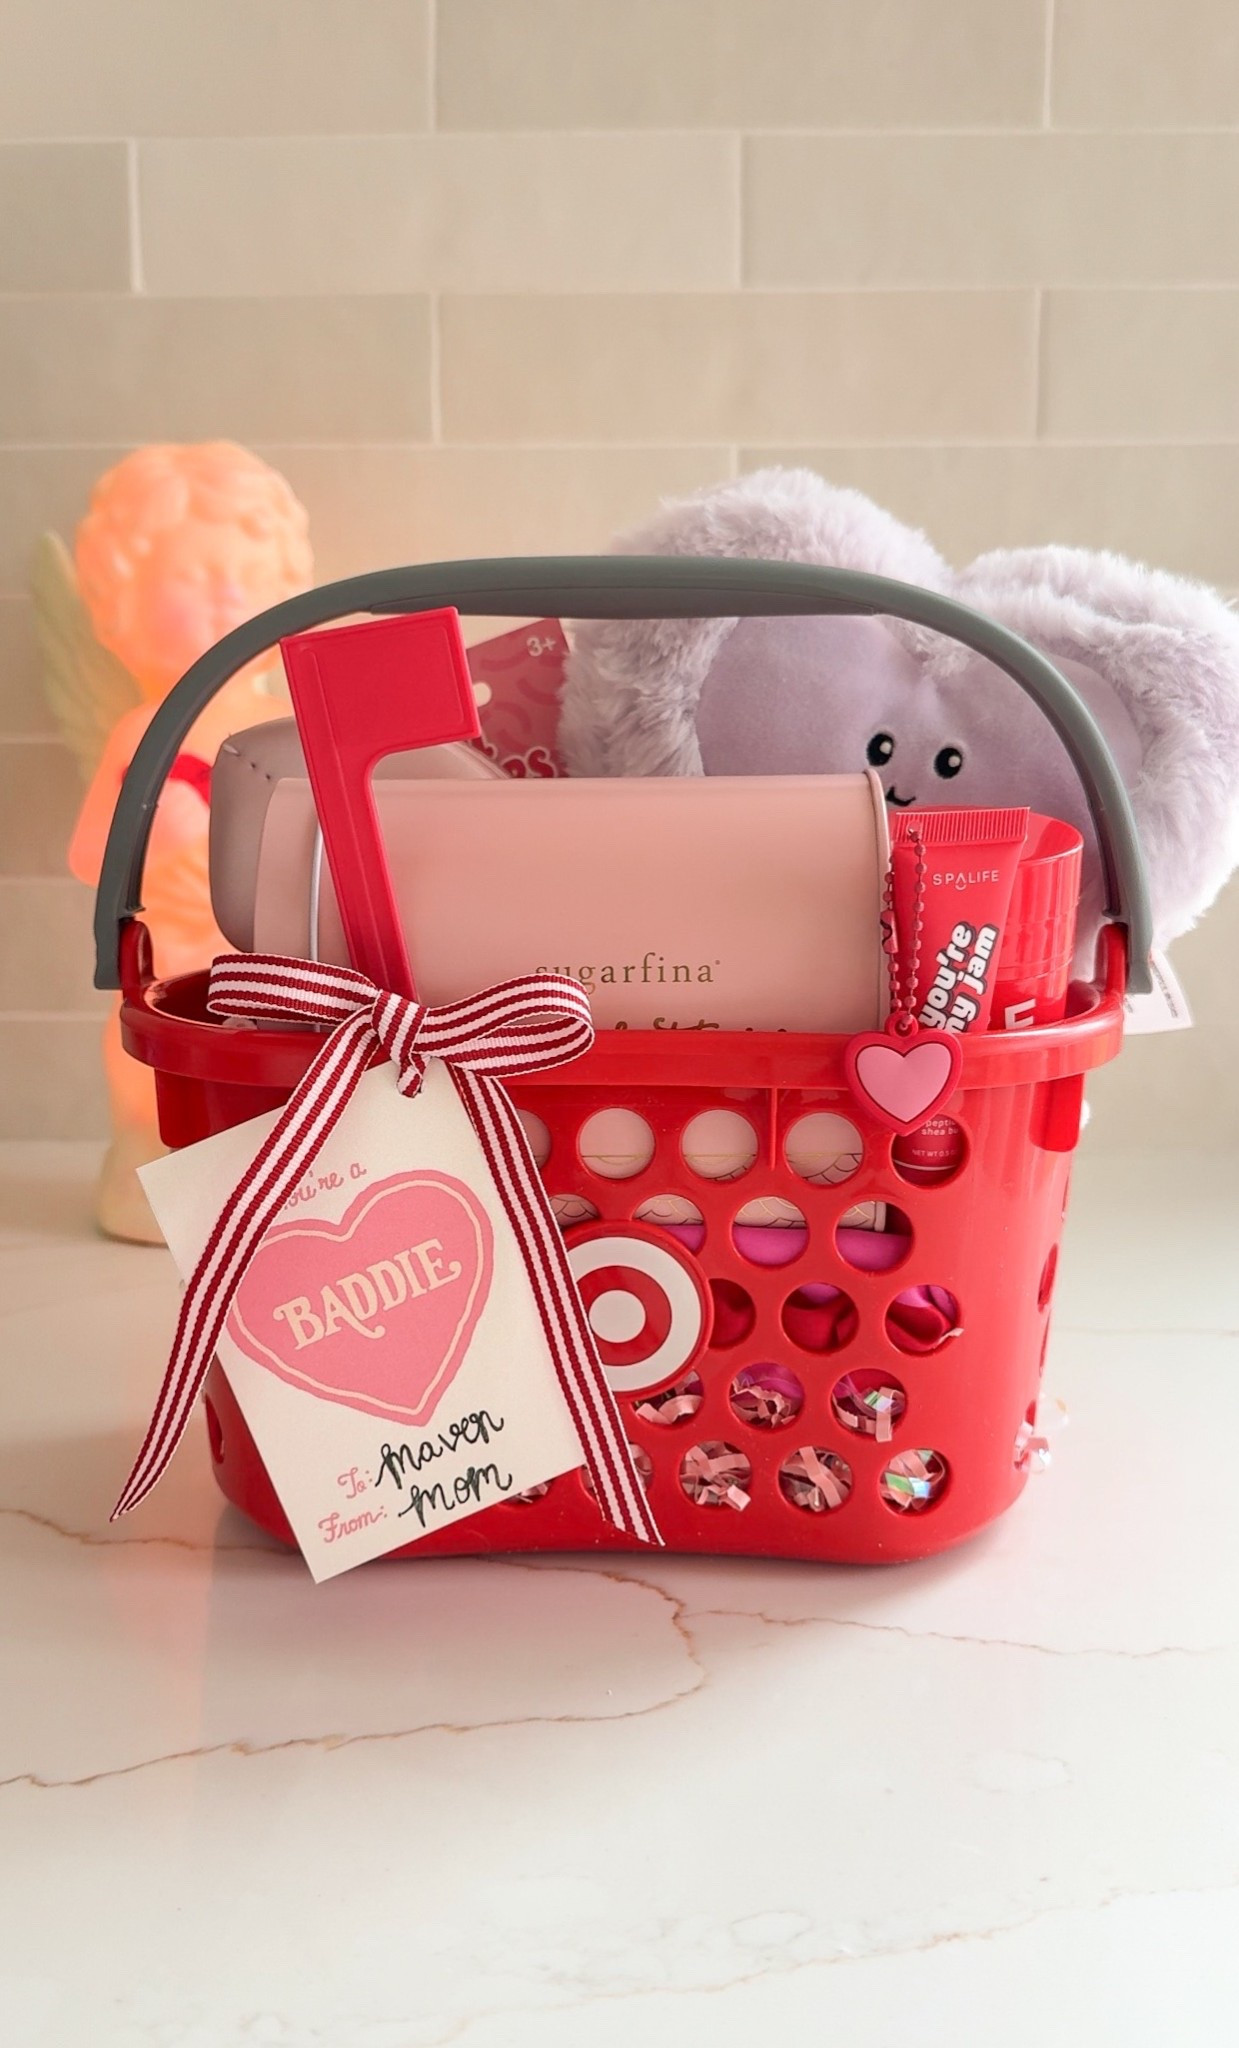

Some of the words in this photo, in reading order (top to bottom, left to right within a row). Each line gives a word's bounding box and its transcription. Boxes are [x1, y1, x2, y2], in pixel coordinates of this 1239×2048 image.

[526, 637, 556, 656] 3+
[932, 870, 999, 890] SPALIFE
[917, 924, 974, 1030] you're
[957, 926, 997, 995] jam
[284, 1170, 345, 1210] ou're
[350, 1162, 367, 1179] a
[272, 1238, 462, 1350] BADDIE
[337, 1466, 373, 1499] To:
[318, 1506, 388, 1543] From:
